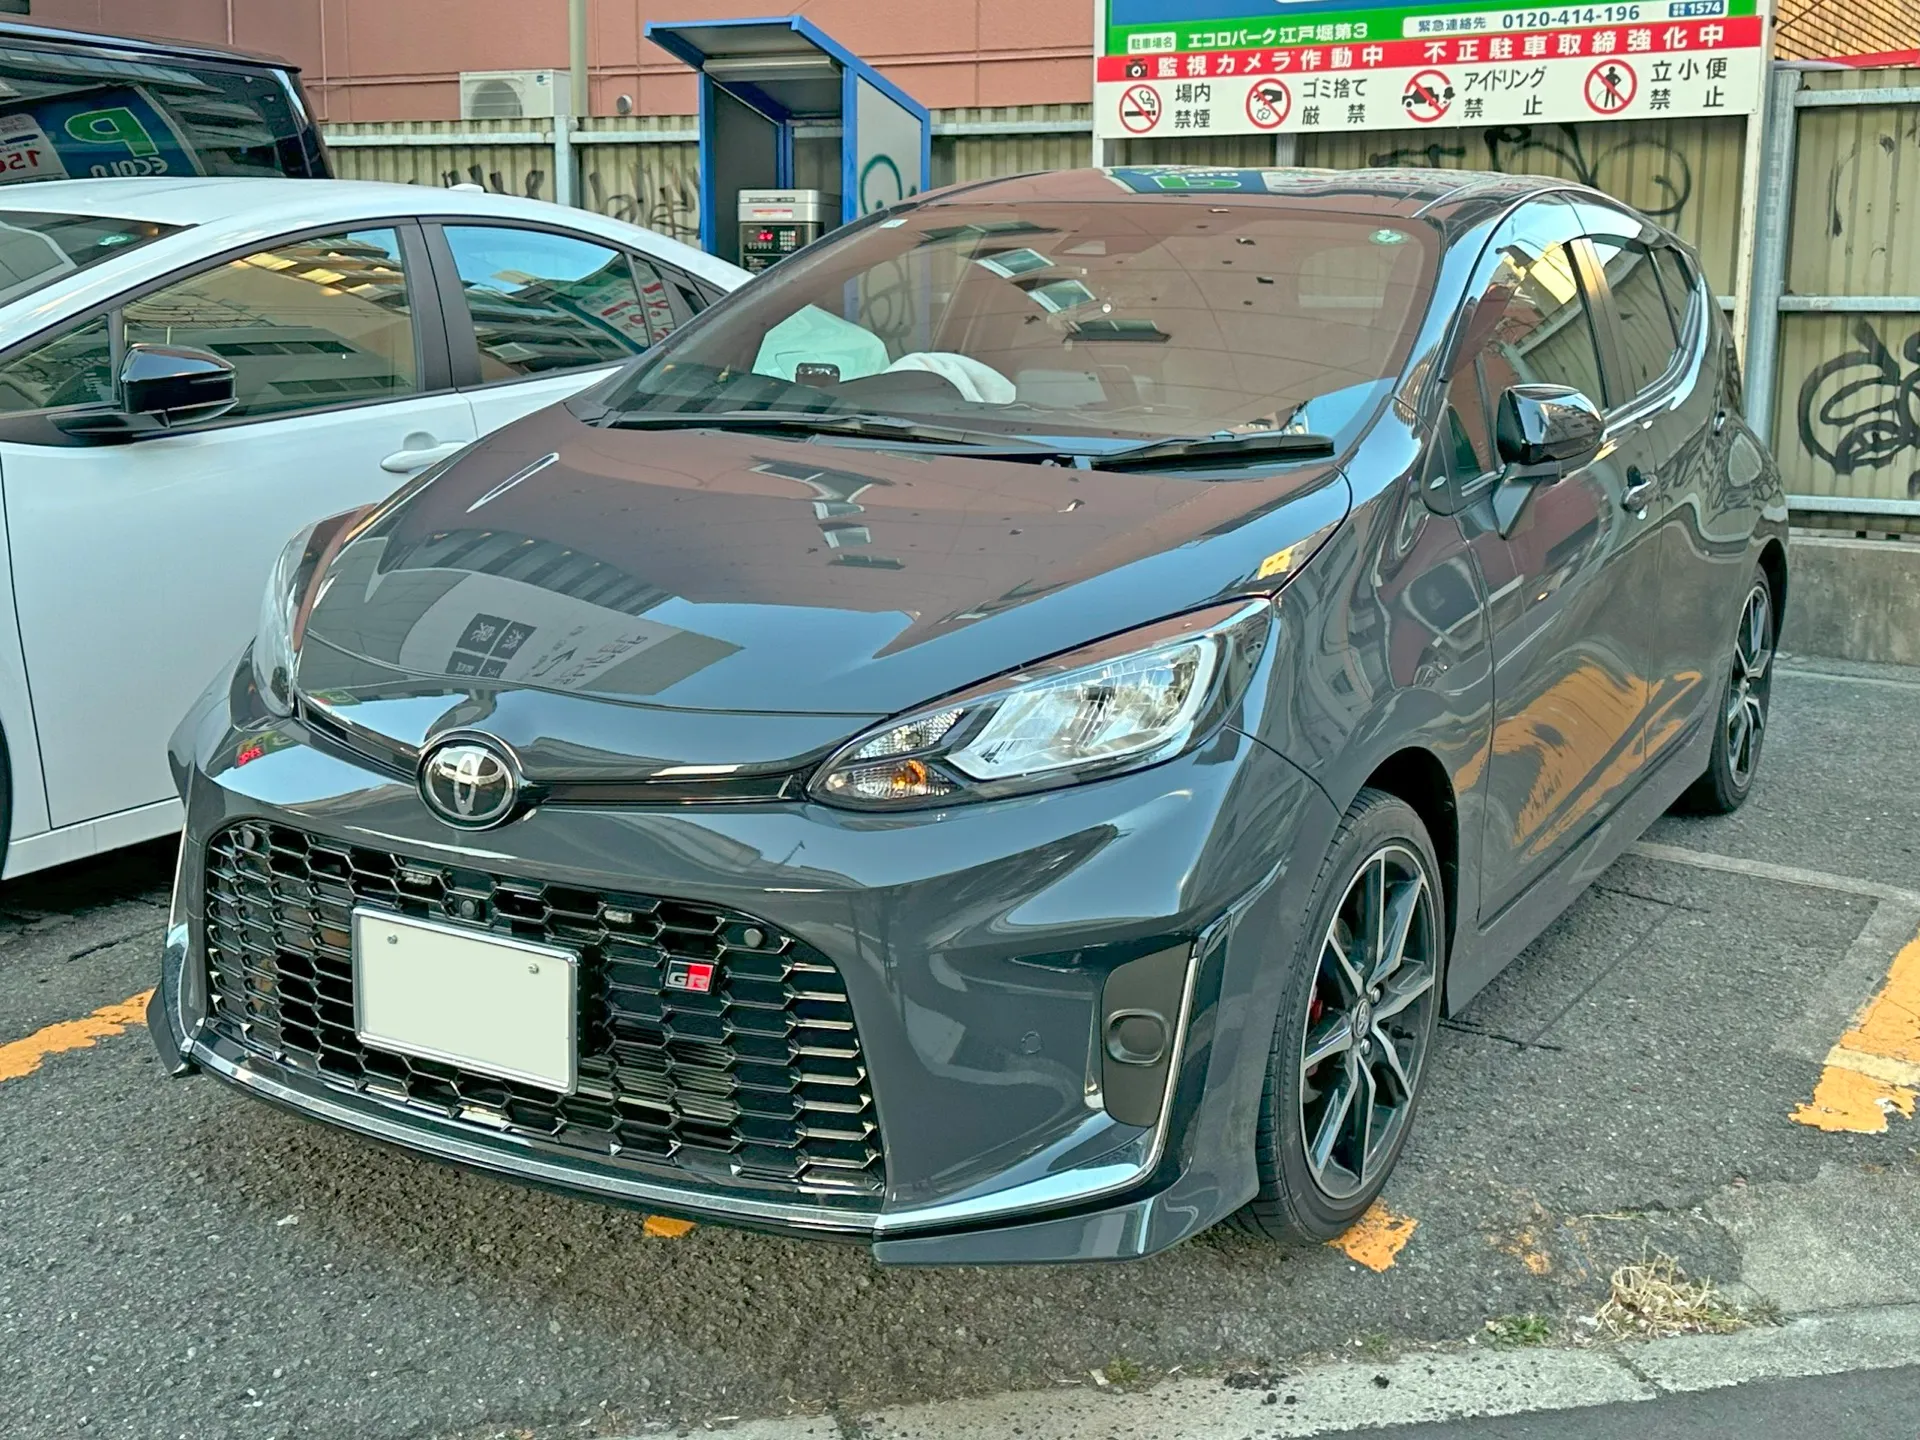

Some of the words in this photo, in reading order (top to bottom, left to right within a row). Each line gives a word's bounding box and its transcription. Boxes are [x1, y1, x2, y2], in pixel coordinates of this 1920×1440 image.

[1502, 5, 1640, 29] 0120-414-196
[1688, 2, 1721, 15] 1574
[1188, 22, 1369, 49] エコロパーク江戸堀第3
[1418, 17, 1487, 32] 緊急連絡先
[1130, 34, 1174, 50] 駐車場名
[1423, 24, 1725, 64] 不正駐車取締強化中
[1157, 45, 1384, 77] 監視カメラ作動中
[1650, 57, 1728, 83] 立小便
[1302, 77, 1368, 99] ゴミ捨て
[1464, 65, 1548, 92] アイドリング
[1175, 82, 1211, 103] 場内
[1650, 85, 1725, 111] 禁止
[1301, 104, 1366, 126] 厳禁
[1463, 94, 1543, 119] 禁止
[1174, 108, 1211, 129] 禁煙
[668, 971, 708, 989] GR
